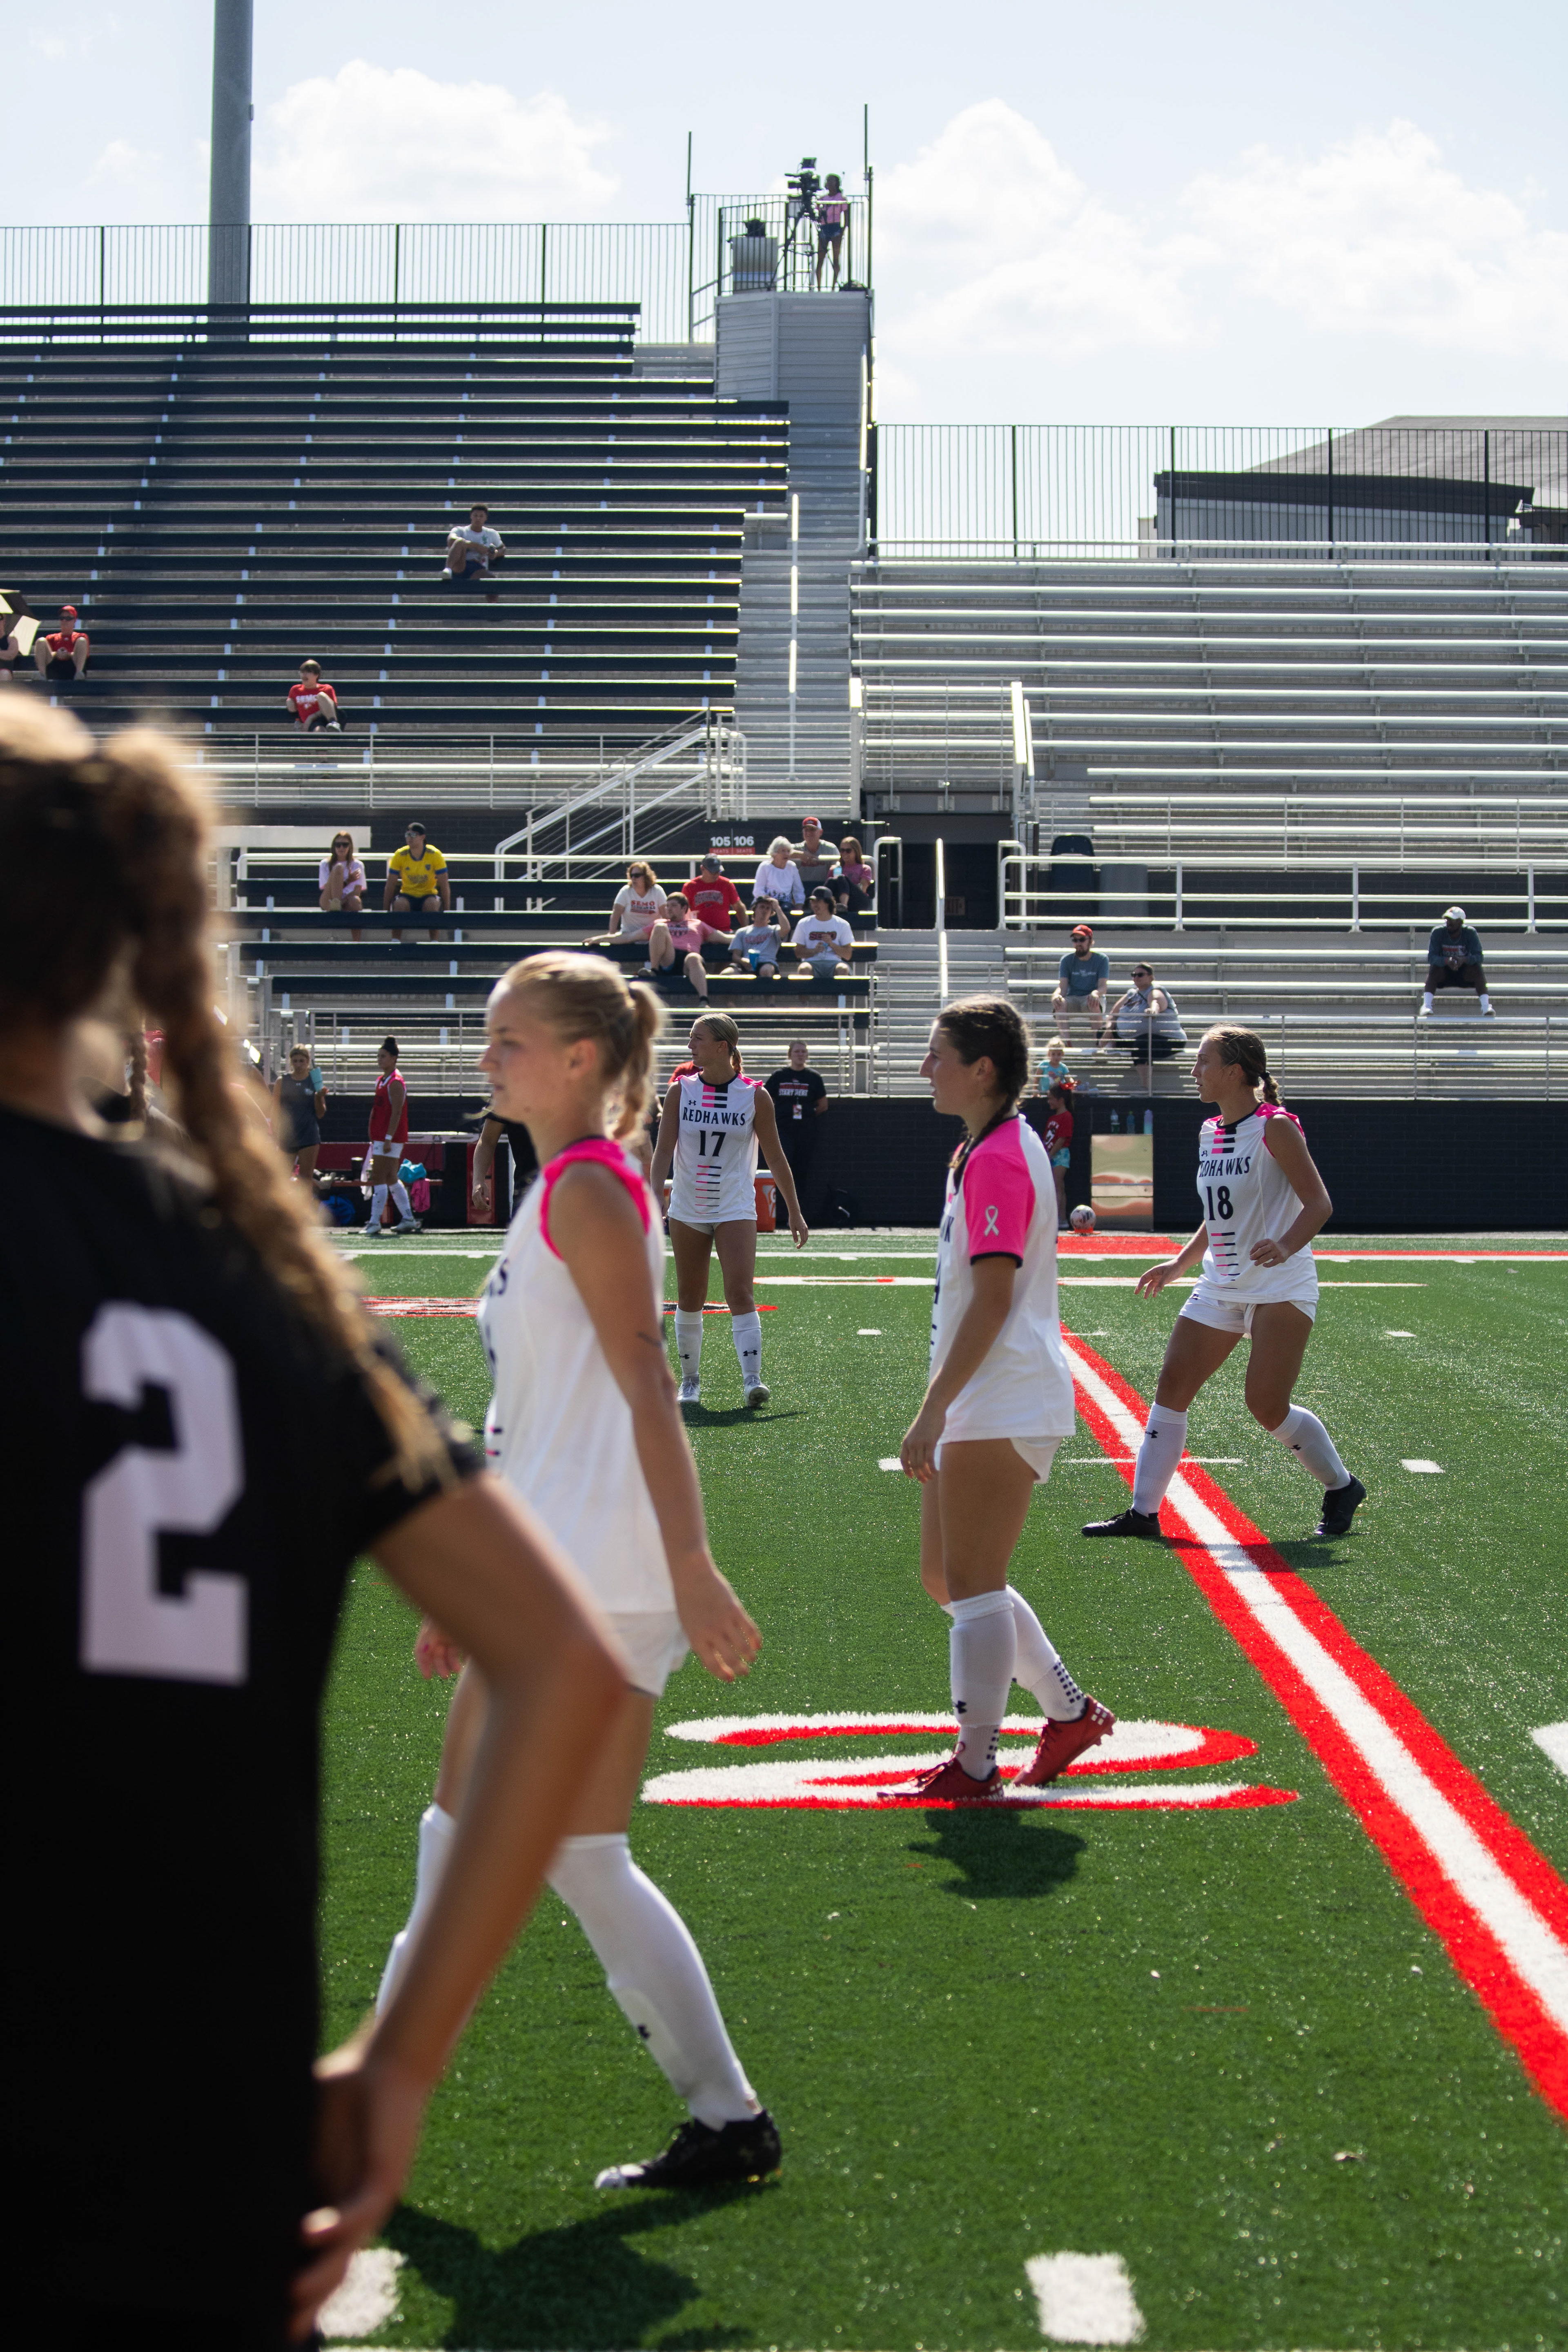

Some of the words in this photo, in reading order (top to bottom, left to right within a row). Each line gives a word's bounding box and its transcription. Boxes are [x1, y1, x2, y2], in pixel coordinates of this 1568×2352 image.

[710, 836, 731, 846] 105
[734, 836, 754, 846] 106
[682, 1107, 746, 1126] REDHAWKS
[699, 1130, 726, 1157] 17
[1206, 1185, 1234, 1221] 18
[81, 1300, 249, 1687] 2
